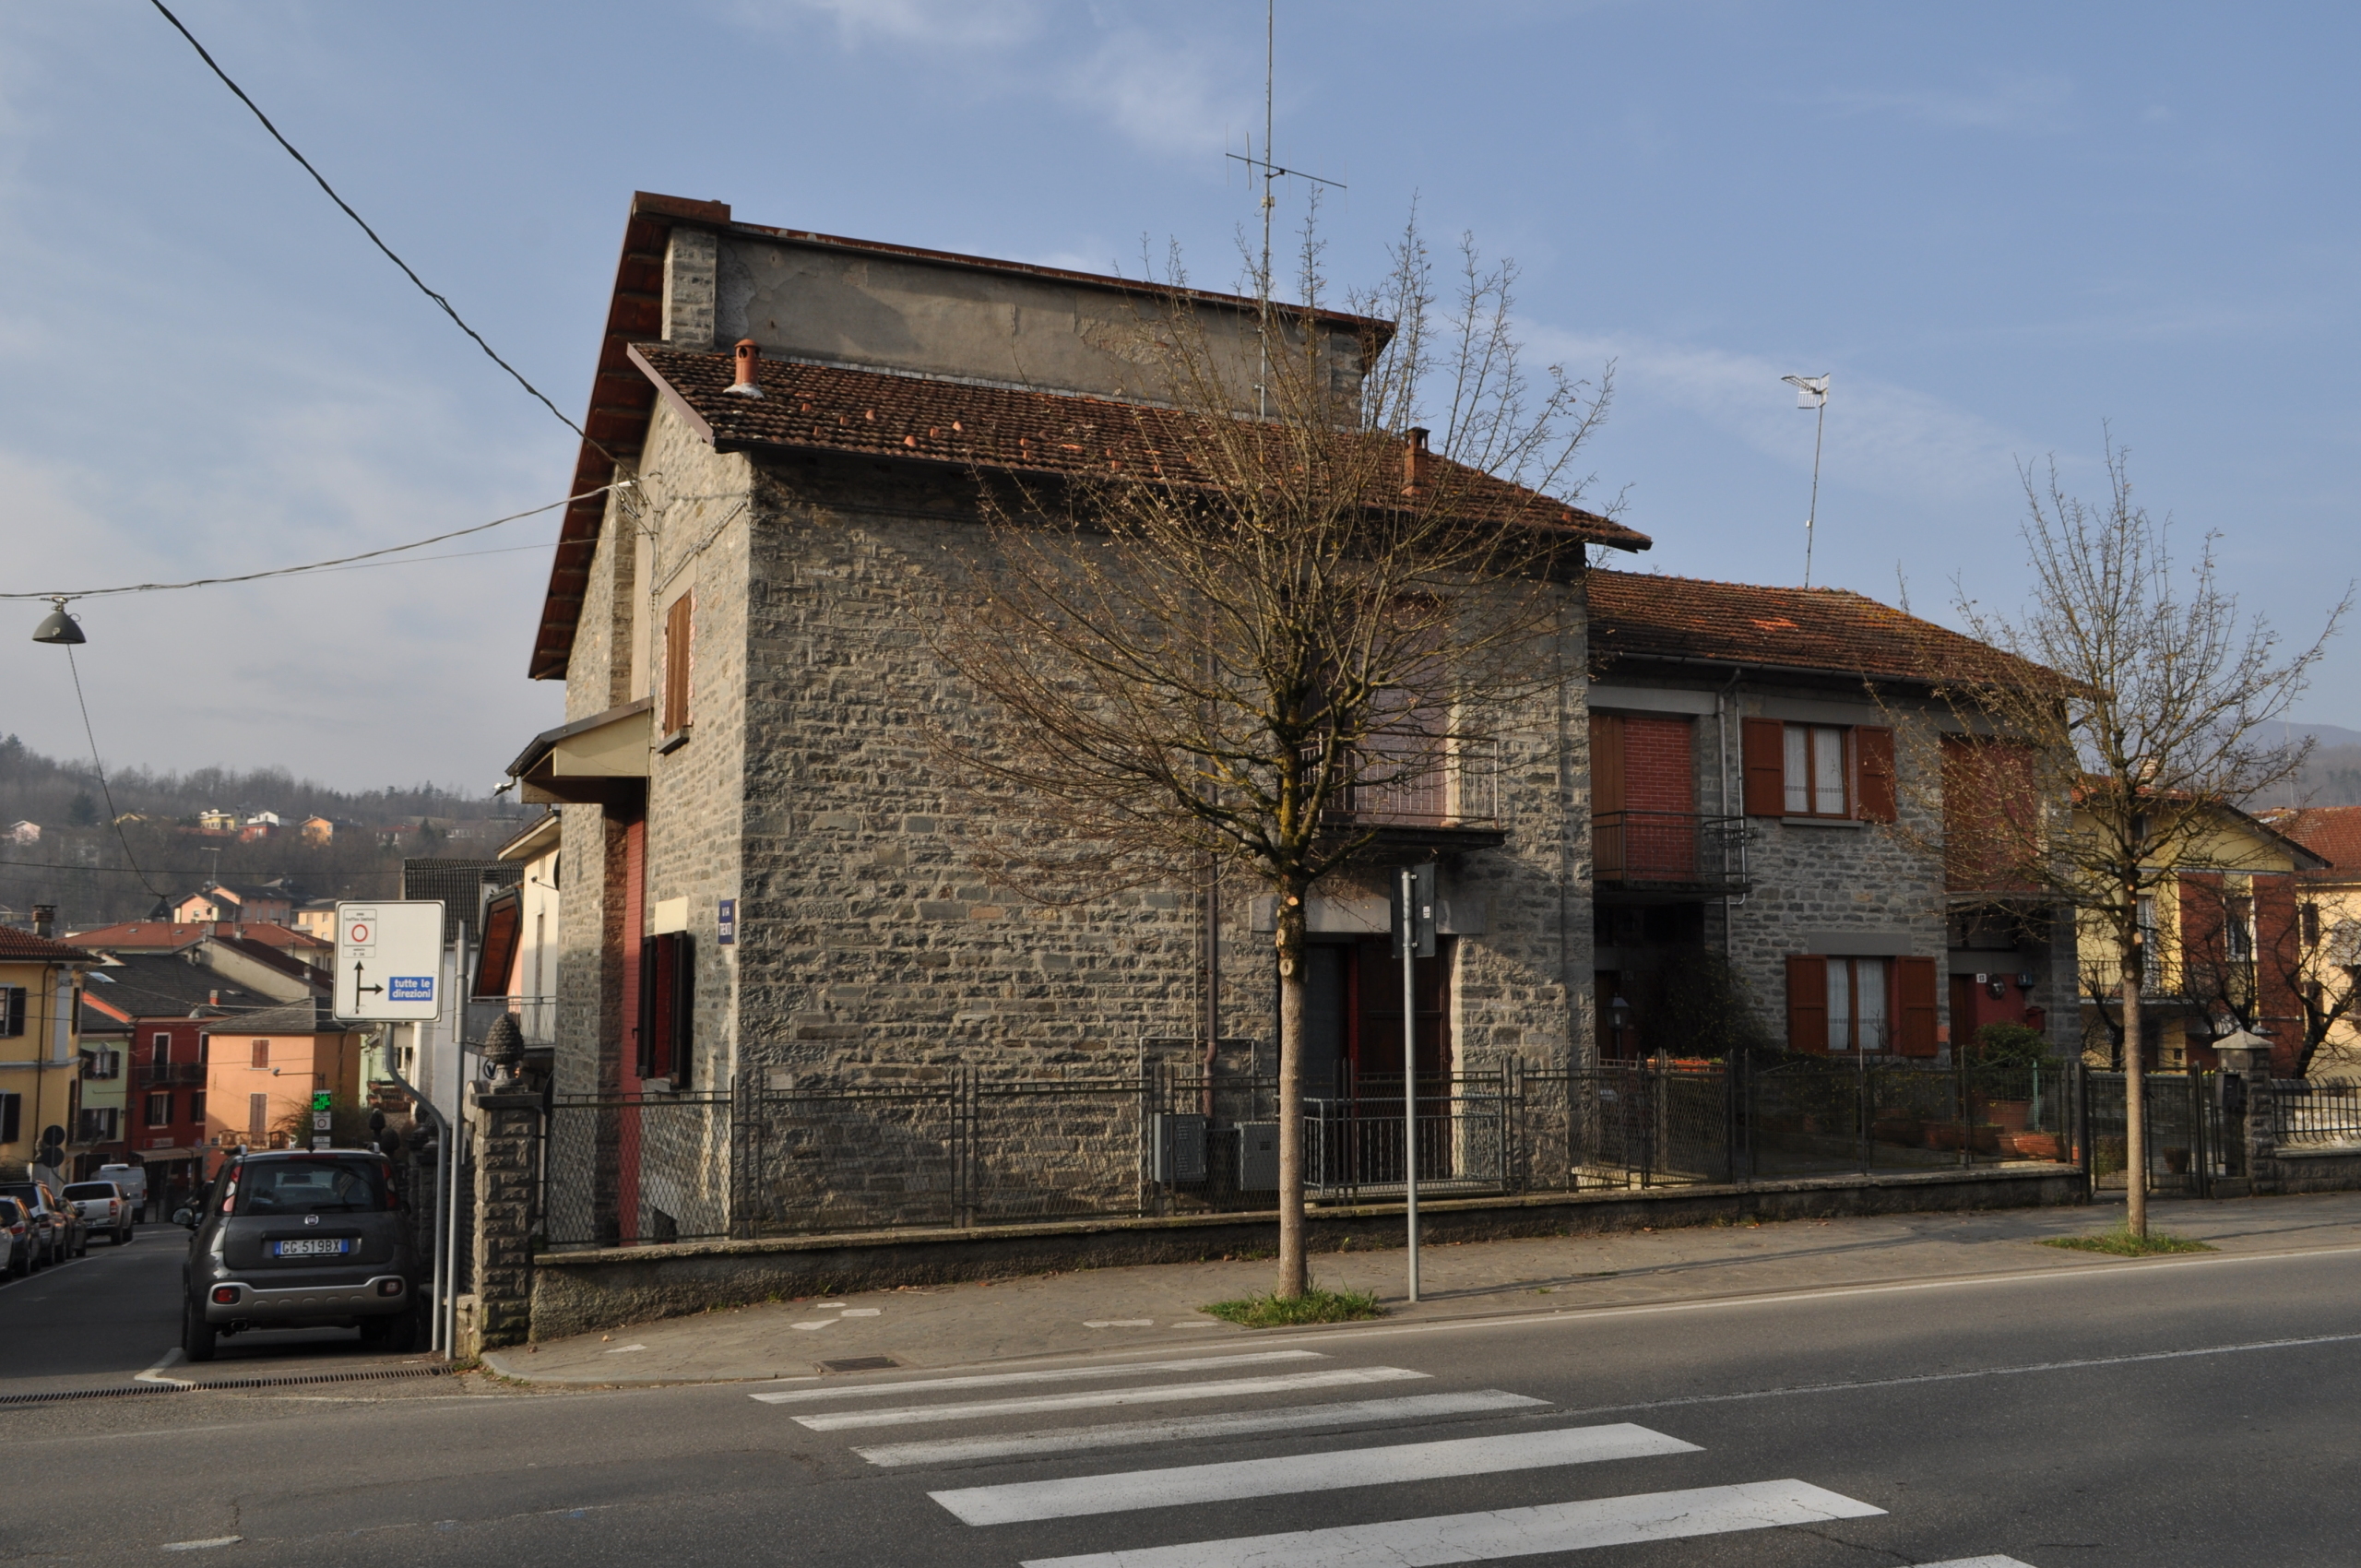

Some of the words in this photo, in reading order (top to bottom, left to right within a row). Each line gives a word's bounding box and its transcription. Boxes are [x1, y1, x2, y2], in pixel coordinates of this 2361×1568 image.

[721, 907, 730, 917] VIA
[394, 979, 418, 988] tutte
[421, 979, 430, 988] le
[392, 989, 431, 998] direzioni
